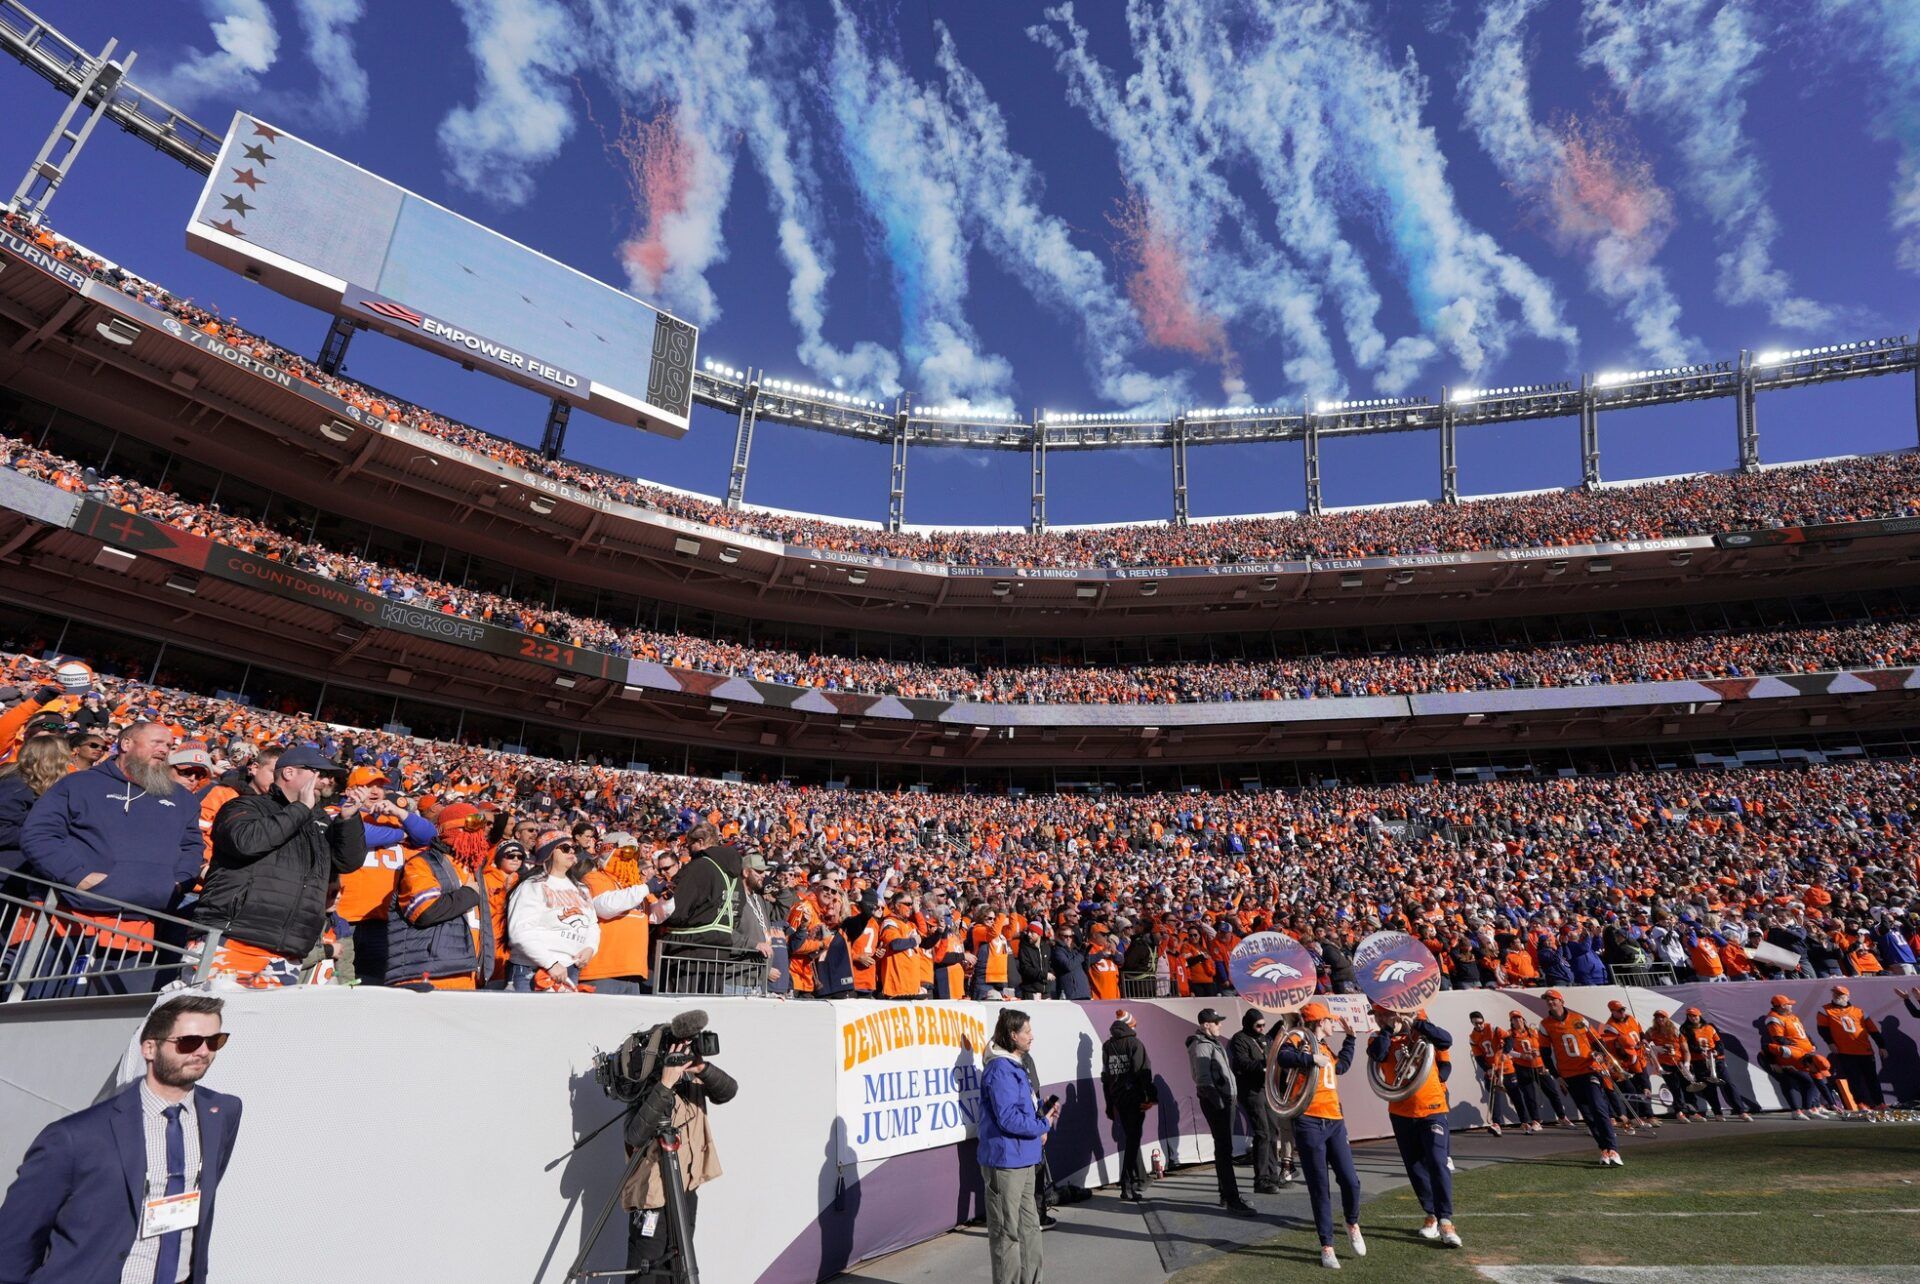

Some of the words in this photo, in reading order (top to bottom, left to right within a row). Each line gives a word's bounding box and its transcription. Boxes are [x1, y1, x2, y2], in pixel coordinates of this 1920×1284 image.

[0, 229, 85, 288] TURNER
[190, 331, 202, 342] 7
[207, 339, 291, 386] MORTON
[423, 318, 524, 369] EMPOWER
[528, 360, 578, 389] FIELD
[366, 416, 382, 428] 57
[403, 430, 473, 463] JACKSON
[540, 480, 557, 492] 49
[574, 491, 612, 511] SMITH
[1510, 548, 1570, 559] SHANAHAN
[1644, 539, 1688, 549] ODOMS
[825, 551, 837, 561] 30
[840, 554, 869, 565] DAVIS
[1221, 565, 1233, 574] 47
[1236, 564, 1269, 574] LYNCH
[1325, 562, 1331, 570] 1
[1333, 560, 1362, 569] ELAM
[1402, 557, 1413, 565] 24
[1417, 555, 1455, 564] BAILEY
[951, 567, 984, 576] SMITH
[1030, 569, 1041, 578] 21
[1044, 569, 1078, 578] MINGO
[1129, 568, 1169, 577] REEVES
[228, 558, 349, 604] COUNTDOWN
[353, 598, 376, 612] TO
[381, 603, 485, 642] KICKOFF
[519, 638, 575, 667] 2:21
[1246, 985, 1313, 1008] STAMPEDE
[1381, 973, 1440, 1010] STAMPEDE
[843, 1006, 914, 1072] DENVER
[914, 1006, 987, 1055] BRONCOS
[1562, 1033, 1580, 1057] 0
[863, 1071, 920, 1104] MILE
[923, 1065, 980, 1097] HIGH
[1323, 1061, 1336, 1089] 0
[856, 1106, 922, 1145] JUMP
[927, 1096, 982, 1132] ZON
